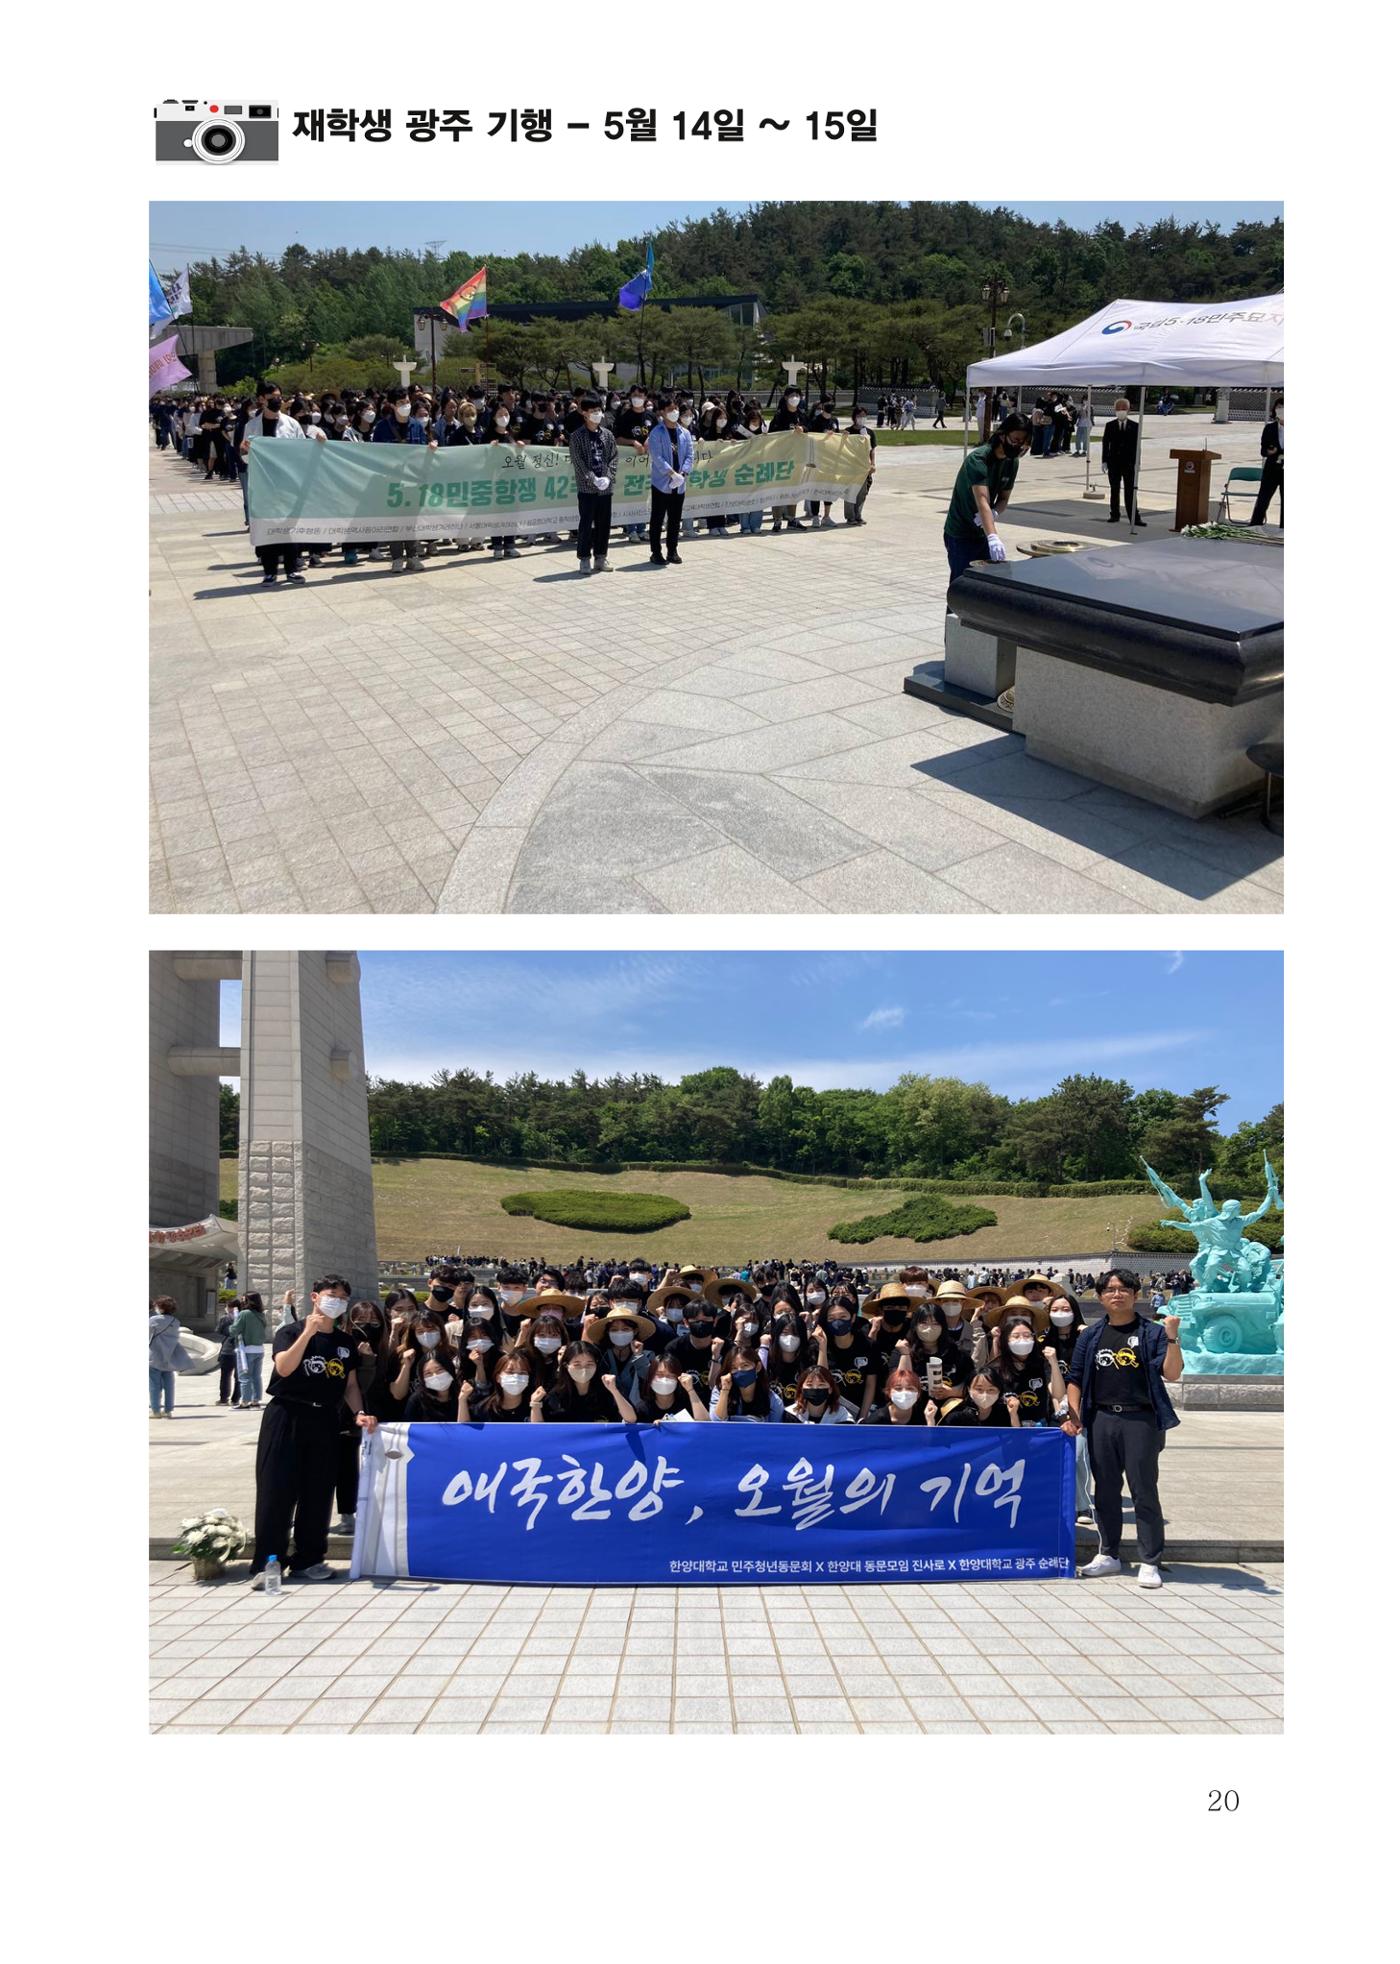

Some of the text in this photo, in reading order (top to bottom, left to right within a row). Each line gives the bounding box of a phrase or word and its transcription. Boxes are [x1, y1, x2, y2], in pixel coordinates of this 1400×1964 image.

[292, 108, 392, 143] 재학생
[405, 108, 473, 143] 광주
[487, 108, 553, 143] 기행
[604, 107, 657, 142] 5월
[674, 108, 744, 142] 14일
[807, 108, 877, 142] 15일
[501, 454, 526, 470] 오월
[532, 452, 559, 469] 정신!
[386, 477, 537, 508] 5.18민중항쟁
[735, 460, 795, 486] 순례단
[441, 1454, 1026, 1531] 애국한양, 오월의 기억
[670, 1556, 1070, 1573] 한양대학교 민주청년동문회 X 한양대 동문모임 진사로 X 한양대학교 광주 순례단
[1208, 1789, 1240, 1812] 20
